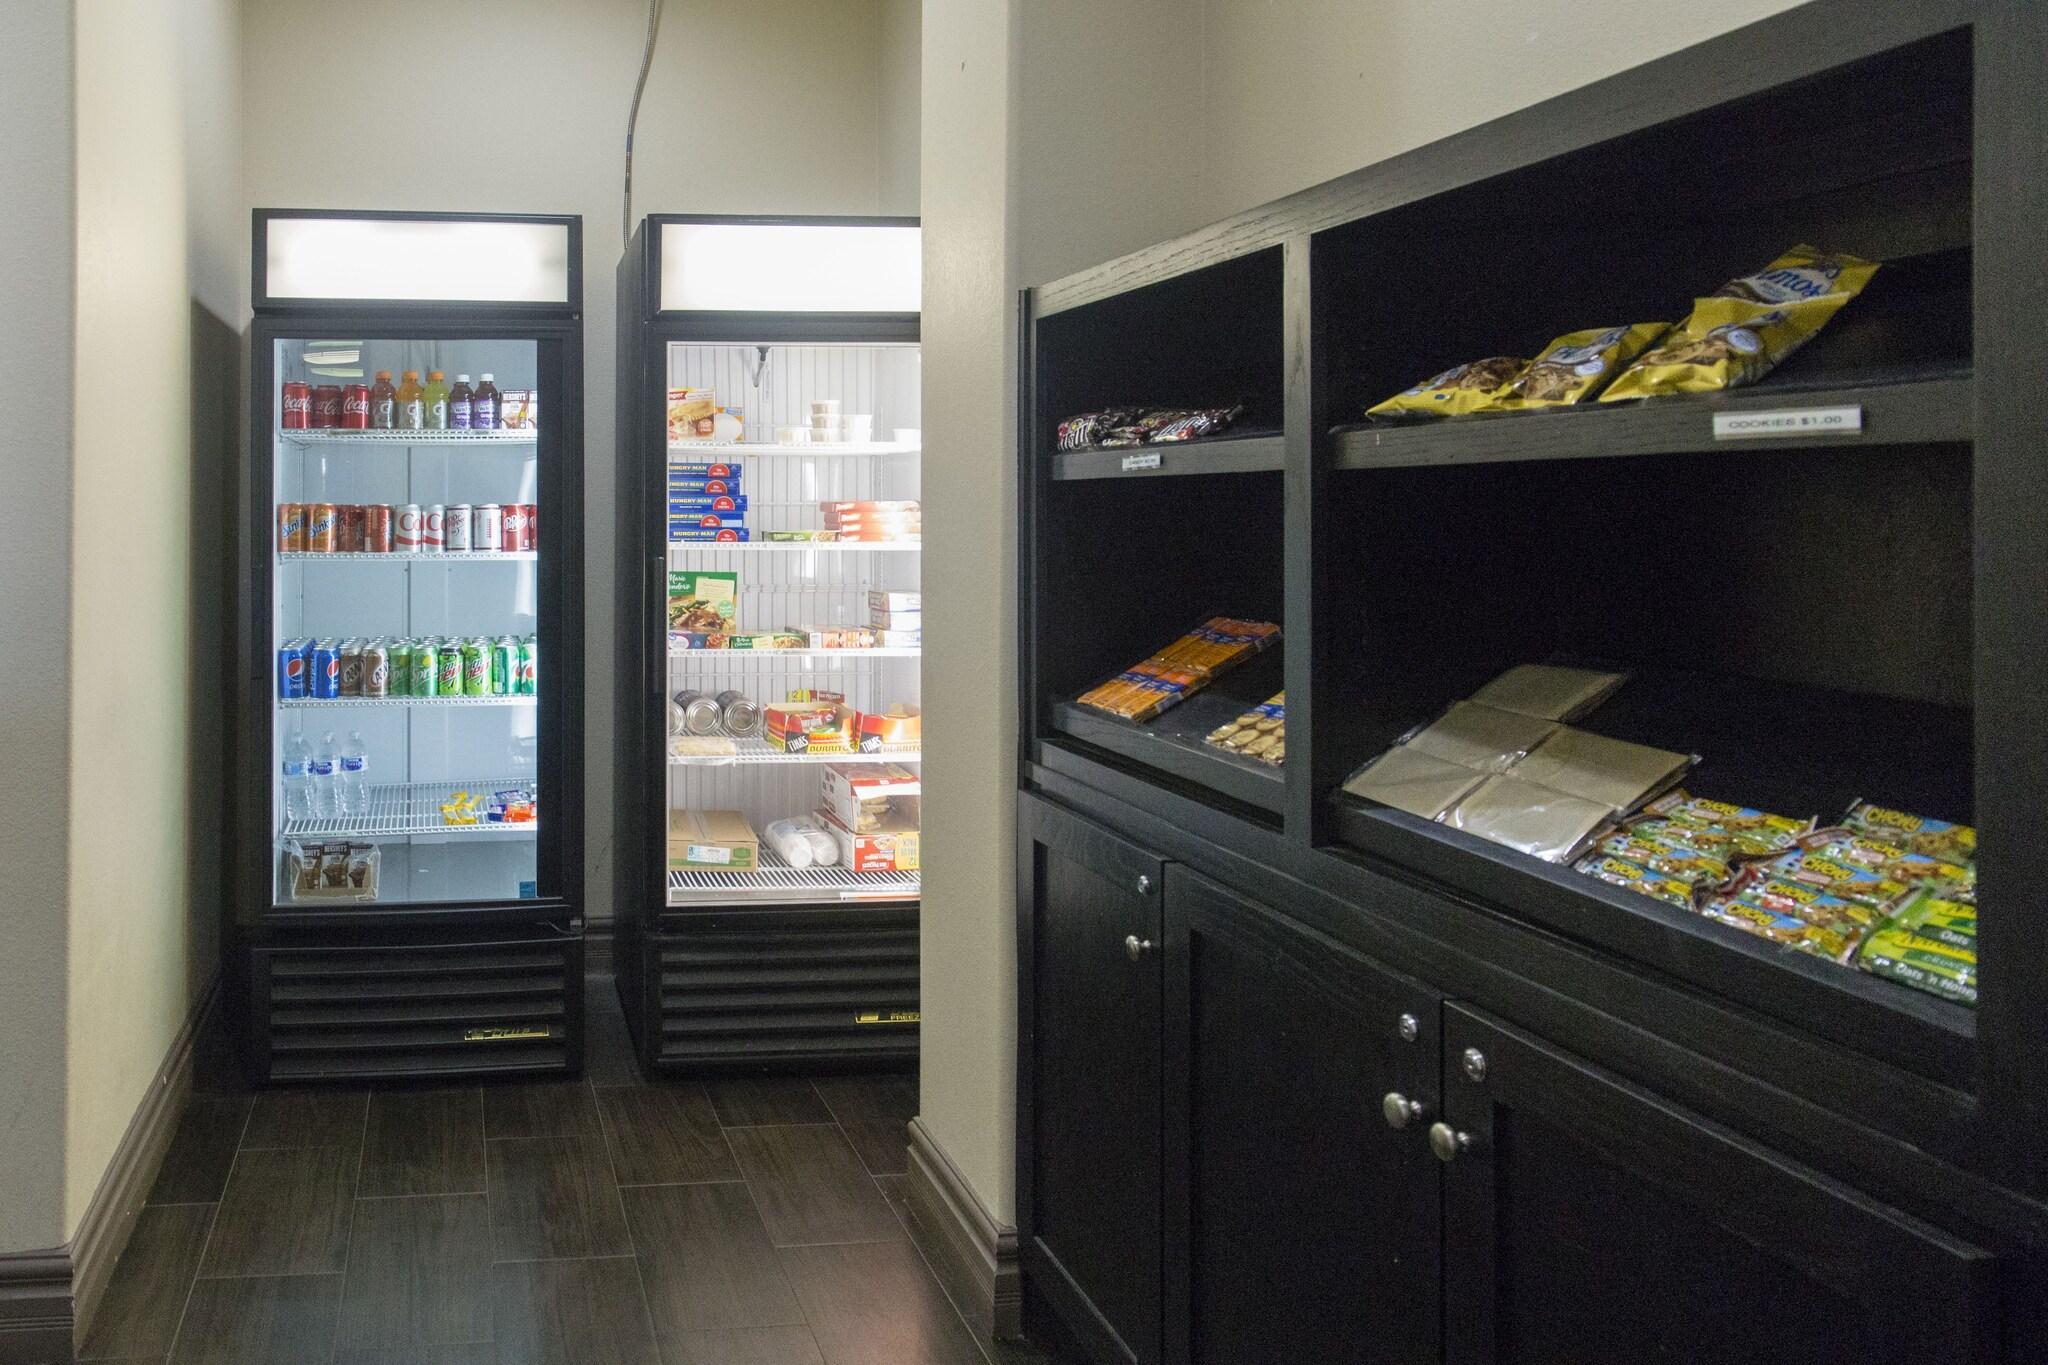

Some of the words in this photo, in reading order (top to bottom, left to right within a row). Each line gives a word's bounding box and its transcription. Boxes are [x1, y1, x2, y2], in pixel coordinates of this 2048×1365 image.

[1728, 418, 1796, 429] COOKIES
[1800, 415, 1842, 426] $1.00
[1941, 929, 1969, 946] Oats
[1896, 962, 1924, 980] Oats
